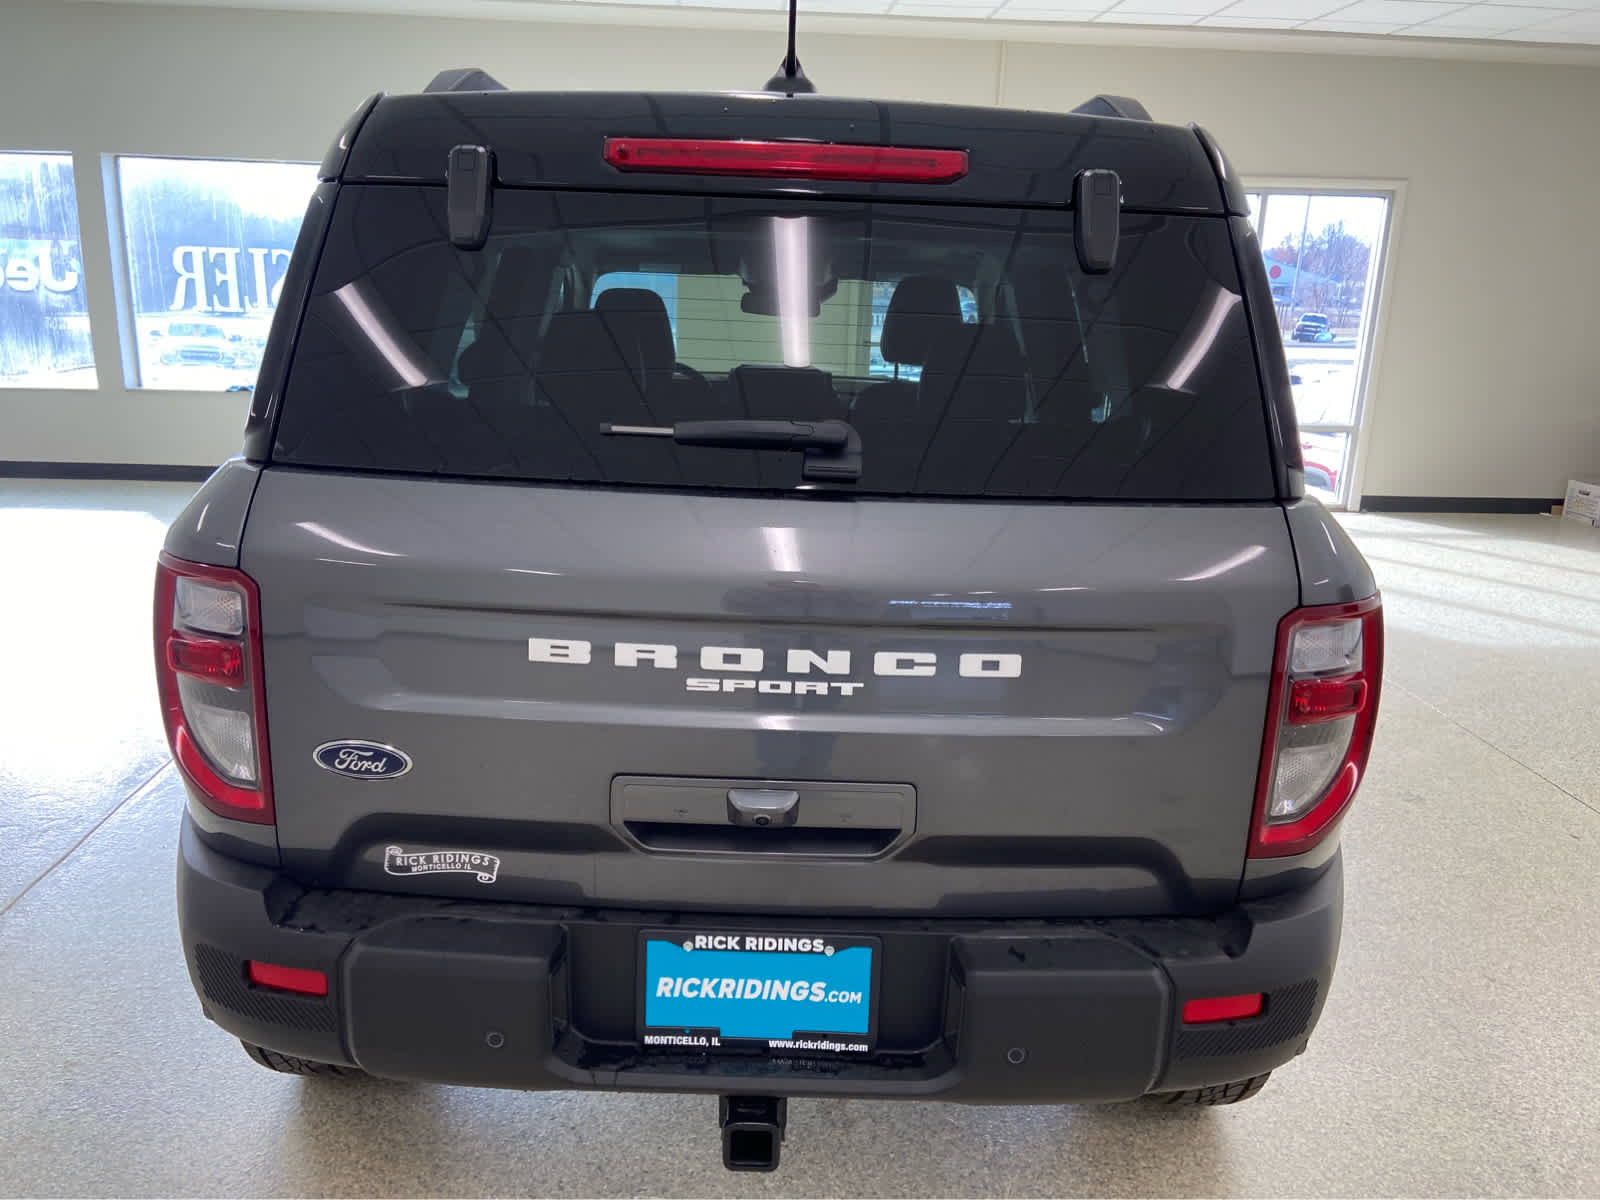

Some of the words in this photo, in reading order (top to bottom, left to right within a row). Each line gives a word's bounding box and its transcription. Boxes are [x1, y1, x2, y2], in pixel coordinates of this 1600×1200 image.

[528, 638, 1022, 678] BRONCO
[686, 678, 864, 696] SPORT
[334, 748, 387, 773] Ford
[396, 856, 427, 866] RICK
[432, 854, 490, 866] RIDINGS
[411, 863, 462, 872] MONTICELLO
[694, 935, 740, 950] RICK
[745, 937, 825, 953] RIDINGS
[656, 977, 862, 1004] RICKRIDINGS.COM
[644, 1035, 709, 1047] MONTICELLO,
[711, 1037, 721, 1046] IL
[768, 1040, 869, 1052] www.rickridings.com
